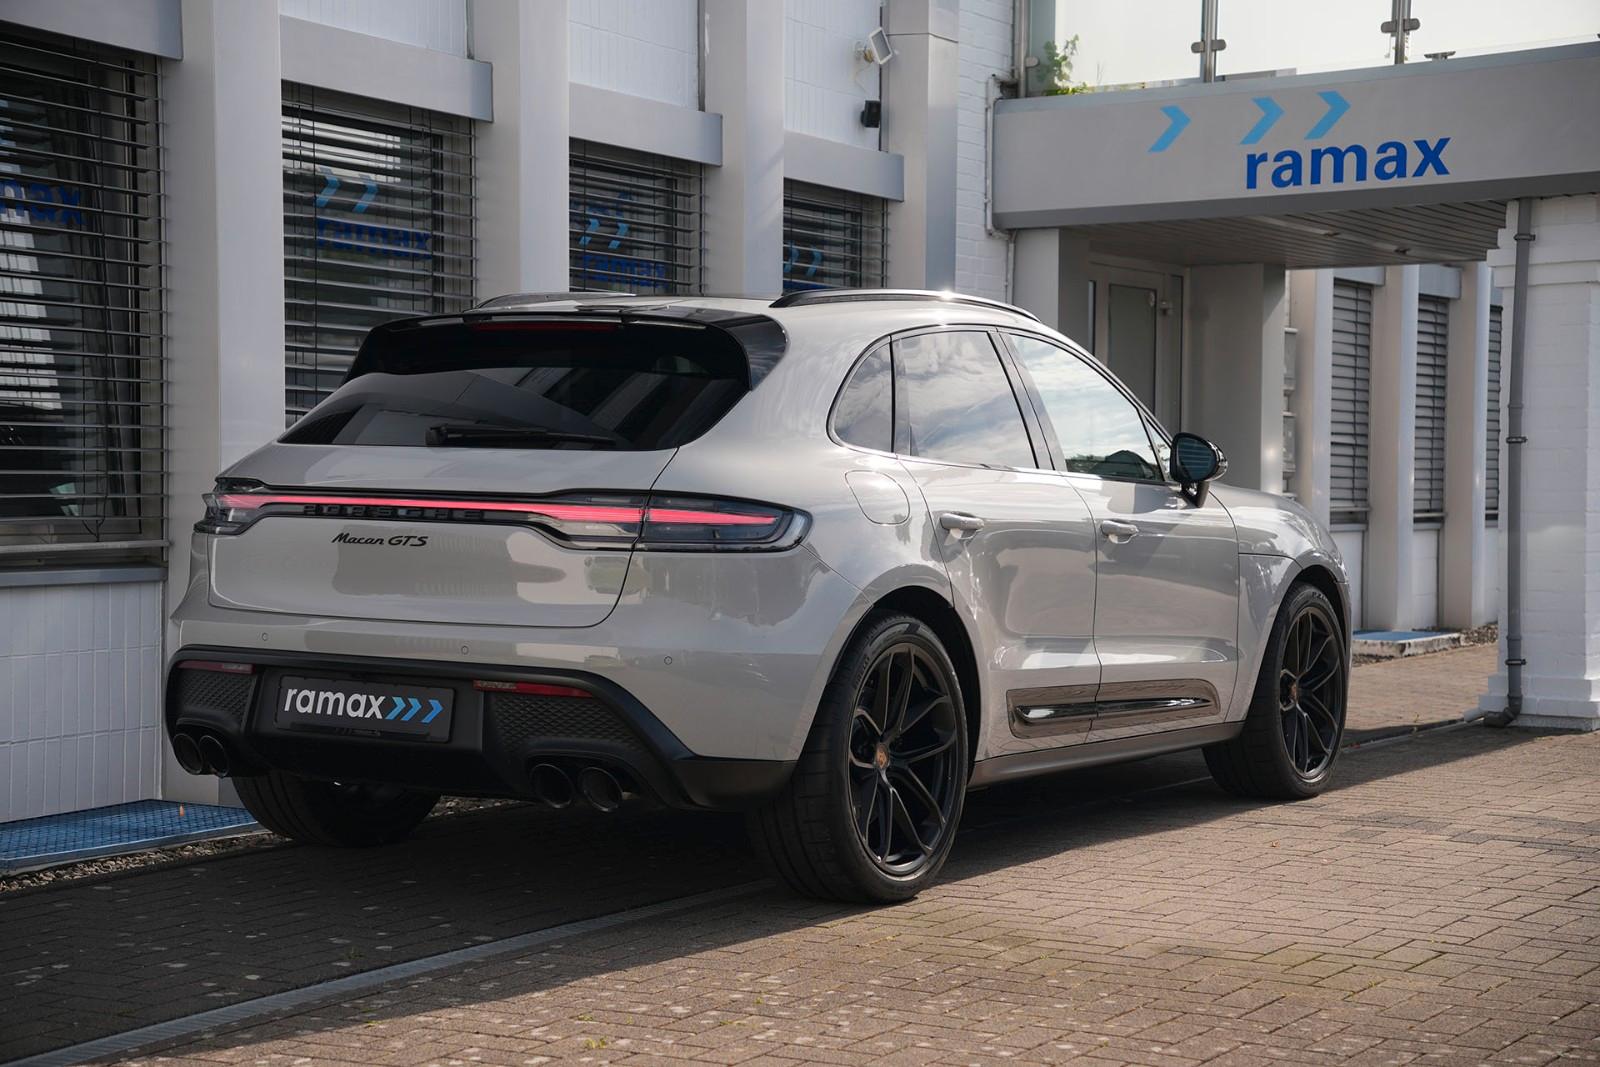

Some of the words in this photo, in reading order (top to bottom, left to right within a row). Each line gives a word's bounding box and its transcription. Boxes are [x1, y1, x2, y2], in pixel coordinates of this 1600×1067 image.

[1245, 137, 1451, 190] ramax
[331, 532, 385, 546] Macan
[388, 535, 429, 547] GTS
[284, 688, 386, 720] ramax
